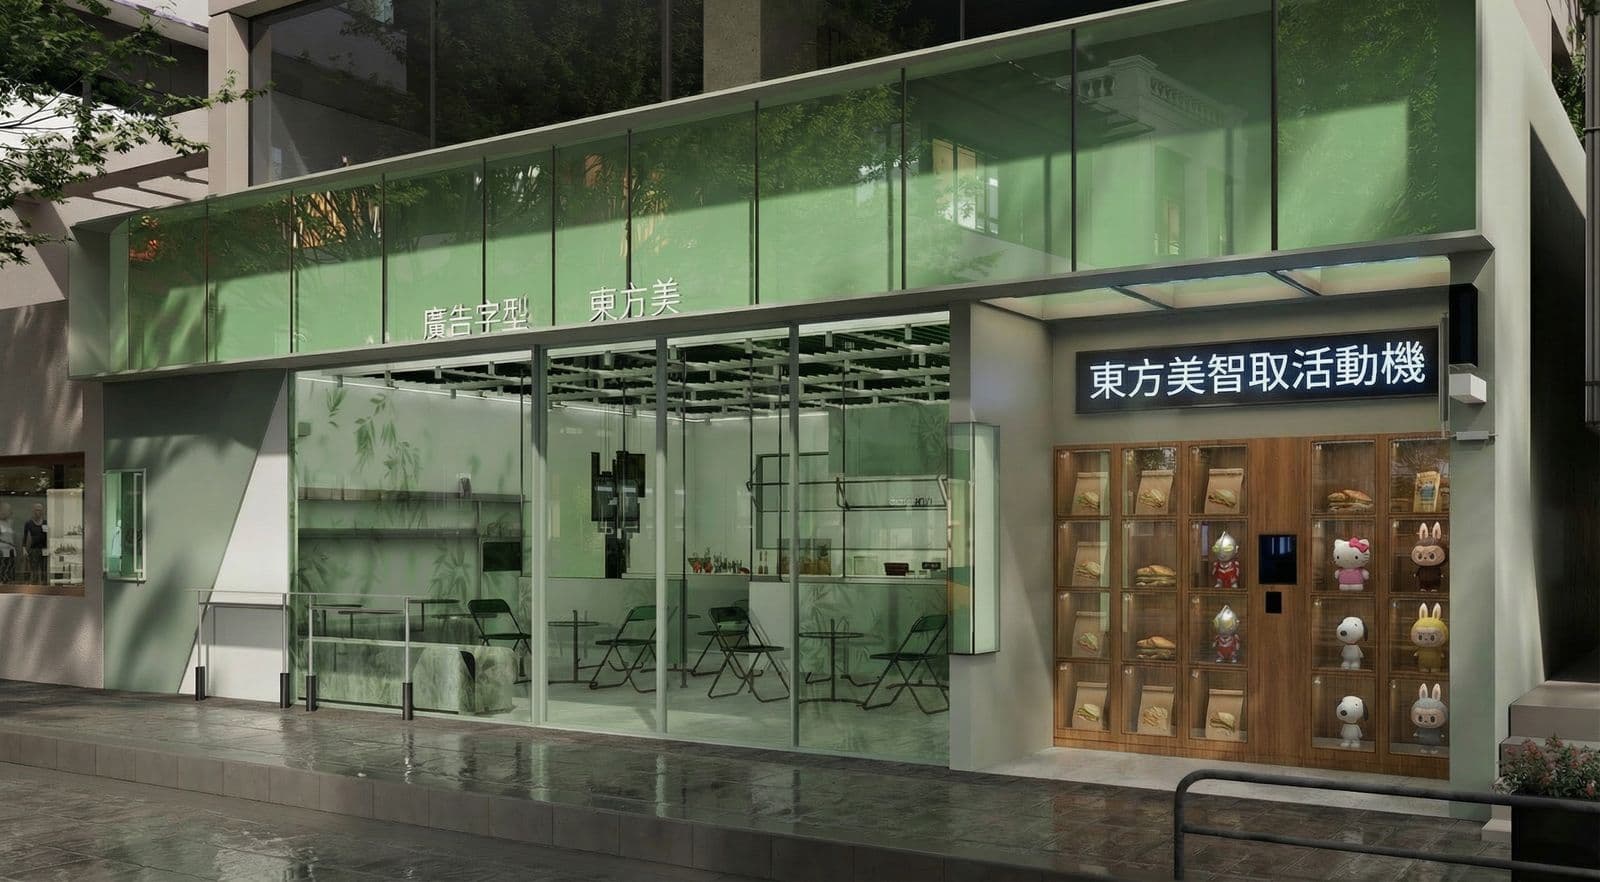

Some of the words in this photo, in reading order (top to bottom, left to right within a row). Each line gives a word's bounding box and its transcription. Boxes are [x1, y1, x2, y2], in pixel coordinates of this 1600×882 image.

[423, 295, 530, 341] 廣告字型
[589, 277, 680, 322] 東方美
[1089, 340, 1426, 400] 東方美智取活動機
